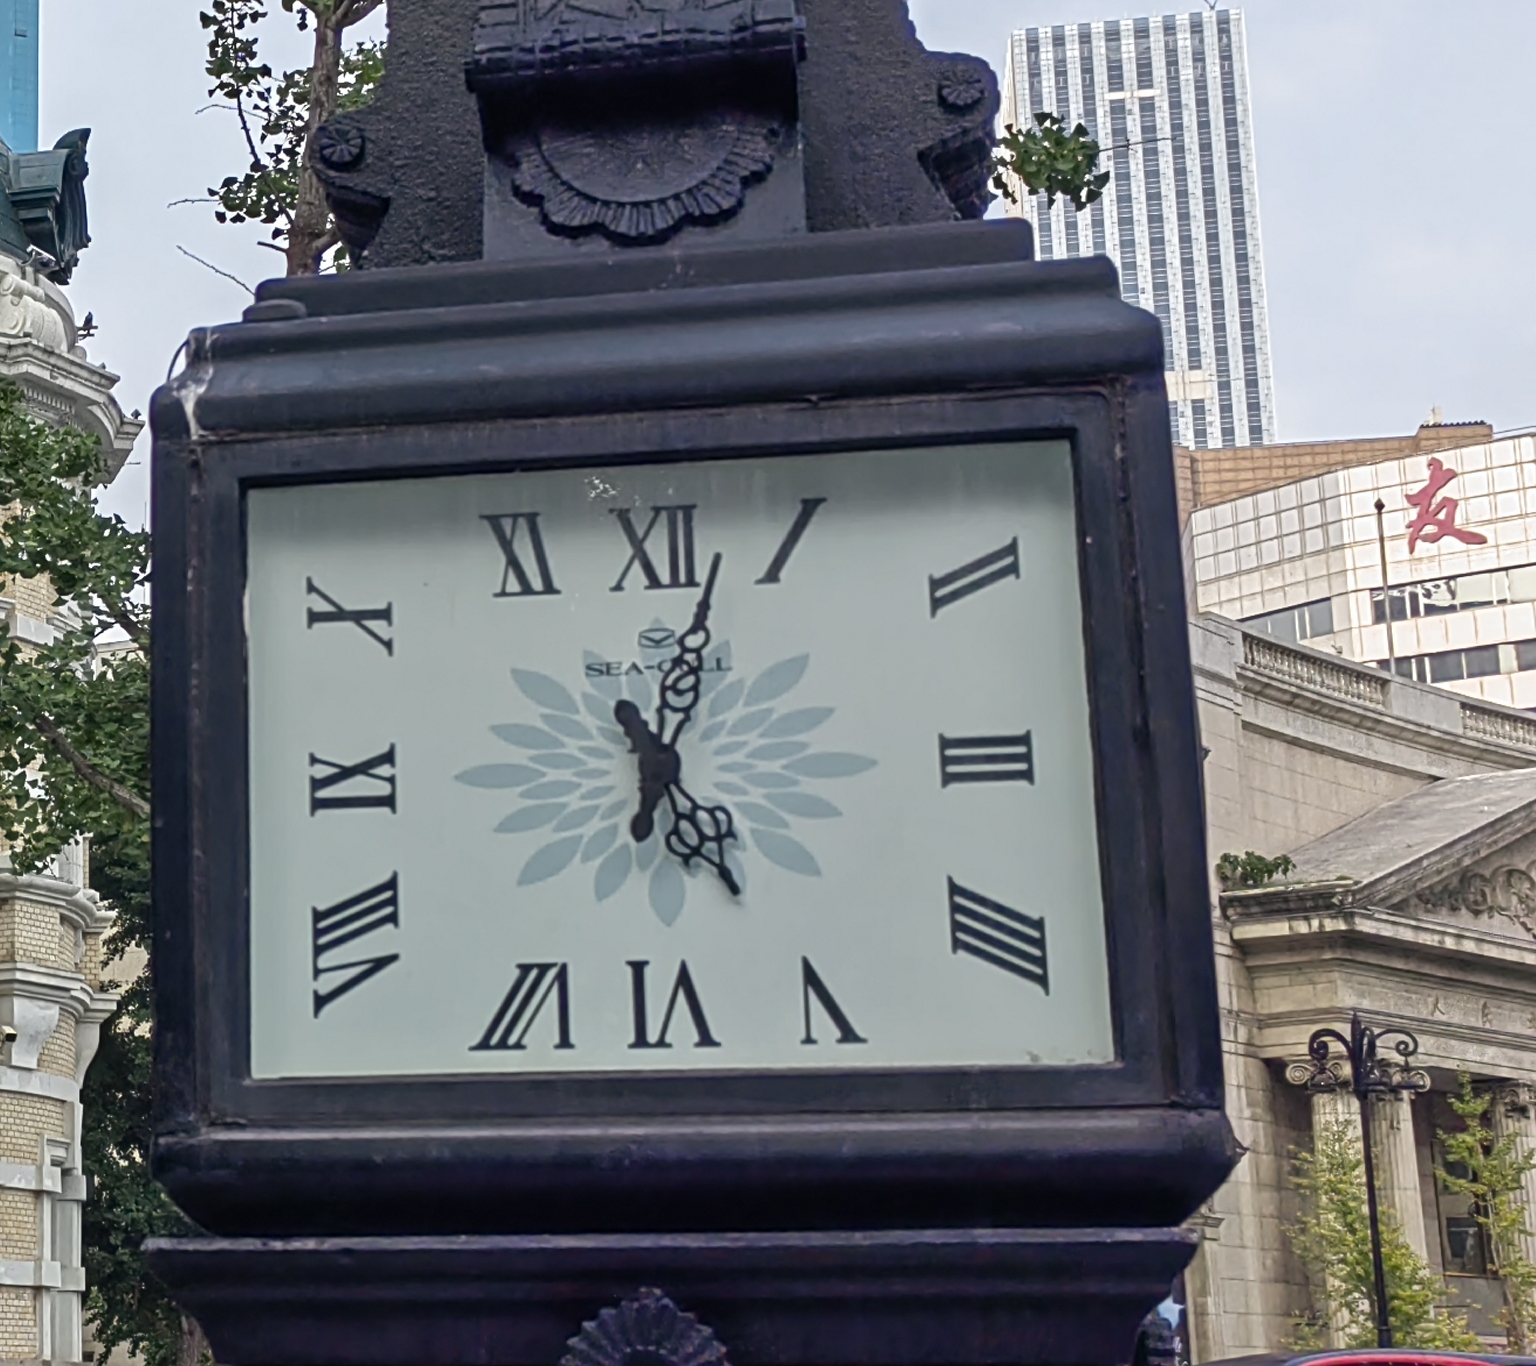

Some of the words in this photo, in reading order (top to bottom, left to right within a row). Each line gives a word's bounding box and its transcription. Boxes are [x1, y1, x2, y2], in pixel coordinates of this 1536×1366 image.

[479, 512, 561, 597] XI
[609, 504, 701, 591] XII
[755, 497, 828, 584] I
[929, 536, 1021, 619] II
[306, 576, 394, 657] X
[584, 657, 733, 677] SEA-GLL
[309, 743, 397, 818] IX
[939, 730, 1035, 787] III
[312, 871, 401, 1019] VIII
[947, 875, 1051, 996] IIII
[467, 961, 576, 1051] VII
[625, 959, 722, 1050] VI
[801, 955, 868, 1045] V
